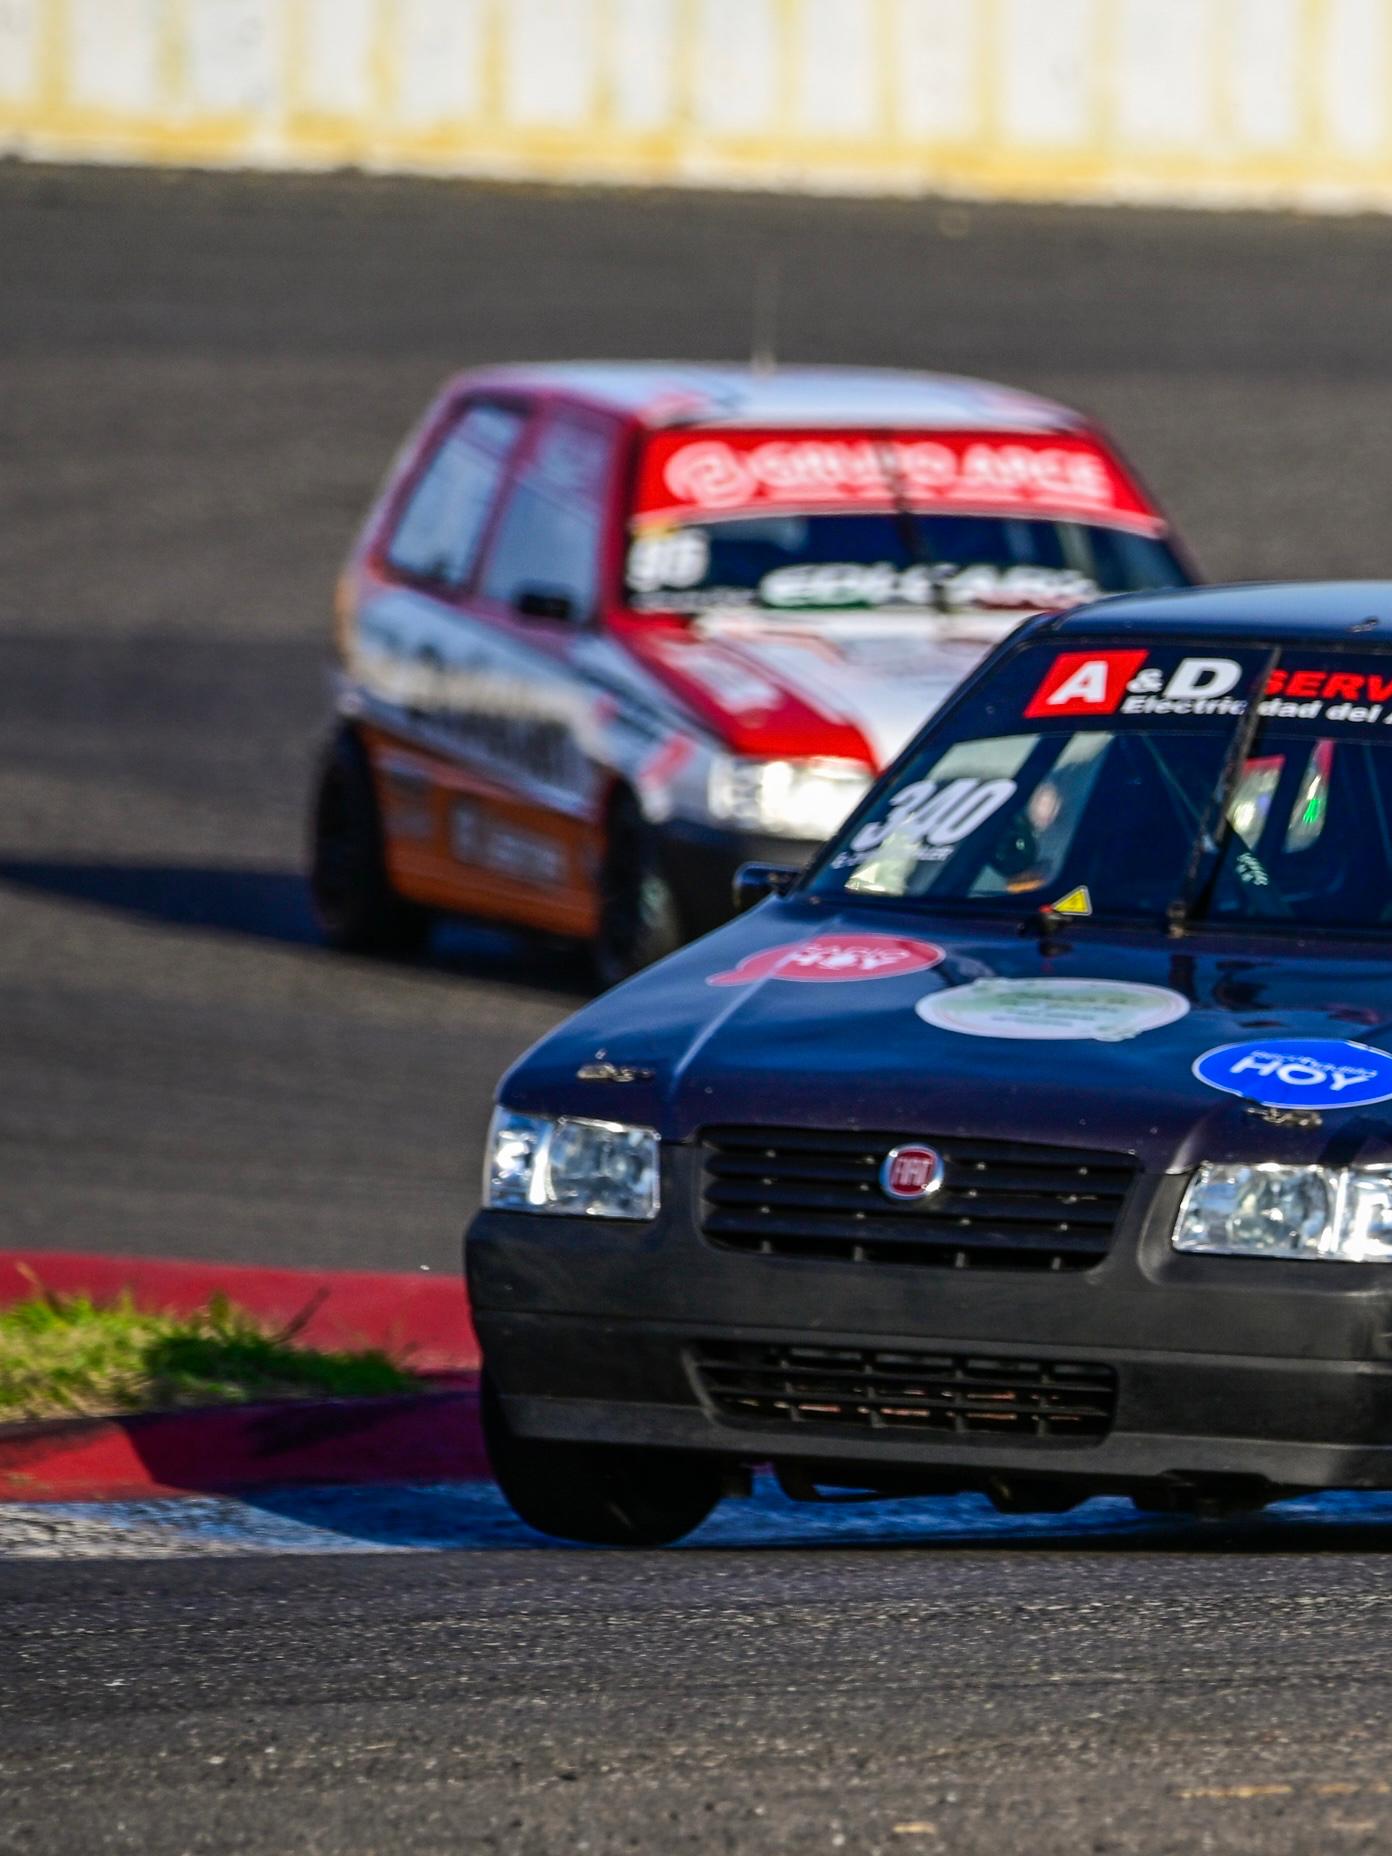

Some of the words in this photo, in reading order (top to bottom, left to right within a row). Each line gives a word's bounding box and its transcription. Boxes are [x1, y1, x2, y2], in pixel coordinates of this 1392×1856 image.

[1046, 660, 1108, 705] A
[1126, 668, 1163, 693] &
[1160, 657, 1242, 699] D
[1119, 695, 1323, 718] Electricdad
[1325, 701, 1384, 724] del
[850, 777, 1018, 850] 340
[1230, 1055, 1371, 1091] HOY
